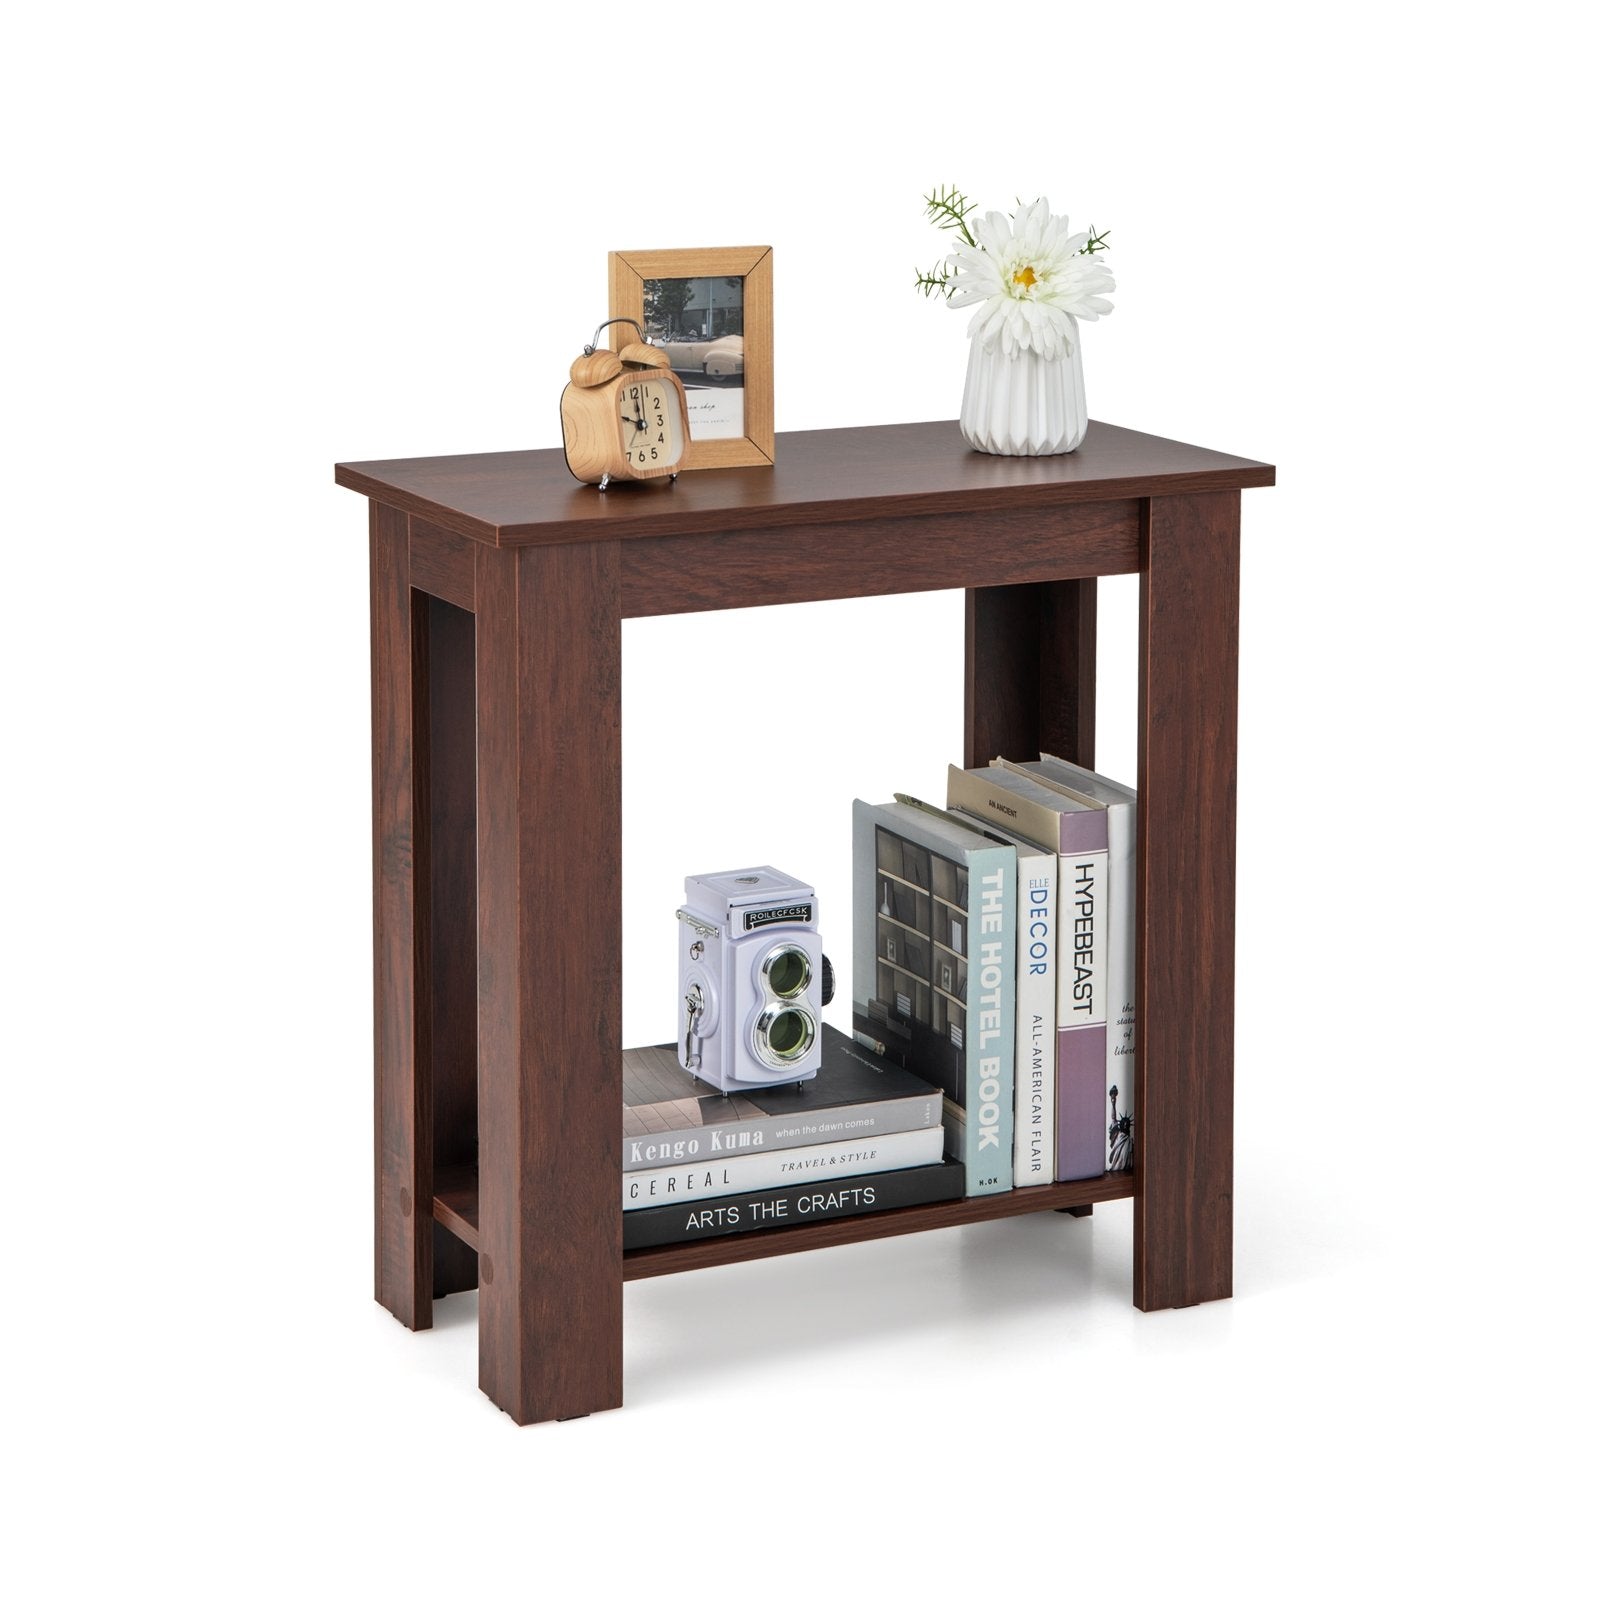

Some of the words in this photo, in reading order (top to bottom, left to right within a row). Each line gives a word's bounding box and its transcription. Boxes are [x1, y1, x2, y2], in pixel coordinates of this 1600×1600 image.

[630, 387, 639, 400] 12
[653, 397, 660, 409] 2
[657, 414, 664, 427] 3
[657, 432, 664, 443] 4
[625, 452, 632, 461] 7
[638, 450, 645, 462] 6
[651, 447, 658, 459] 5
[1029, 878, 1050, 889] ELLE
[981, 868, 1004, 934] THE
[1029, 889, 1049, 976] DECOR
[1073, 863, 1094, 1016] HYPEBEAST
[979, 942, 1002, 1050] HOTEL
[1122, 1002, 1135, 1013] the
[1123, 1027, 1132, 1041] of
[1114, 1045, 1136, 1056] libert
[1031, 1015, 1043, 1124] ALL-AMERICAN
[978, 1055, 1000, 1152] BOOK
[775, 1124, 801, 1138] when
[802, 1122, 817, 1134] the
[818, 1120, 843, 1133] dawn
[845, 1117, 875, 1129] comes
[630, 1139, 699, 1164] Kengo
[710, 1130, 764, 1152] Kuma
[1031, 1130, 1042, 1172] FLAIR
[780, 1159, 827, 1173] TRAVEL
[829, 1156, 837, 1165] &
[839, 1150, 878, 1164] STYLE
[630, 1169, 730, 1199] CEREAL
[685, 1206, 740, 1231] ARTS
[748, 1199, 789, 1221] THE
[797, 1187, 876, 1214] CRAFTS
